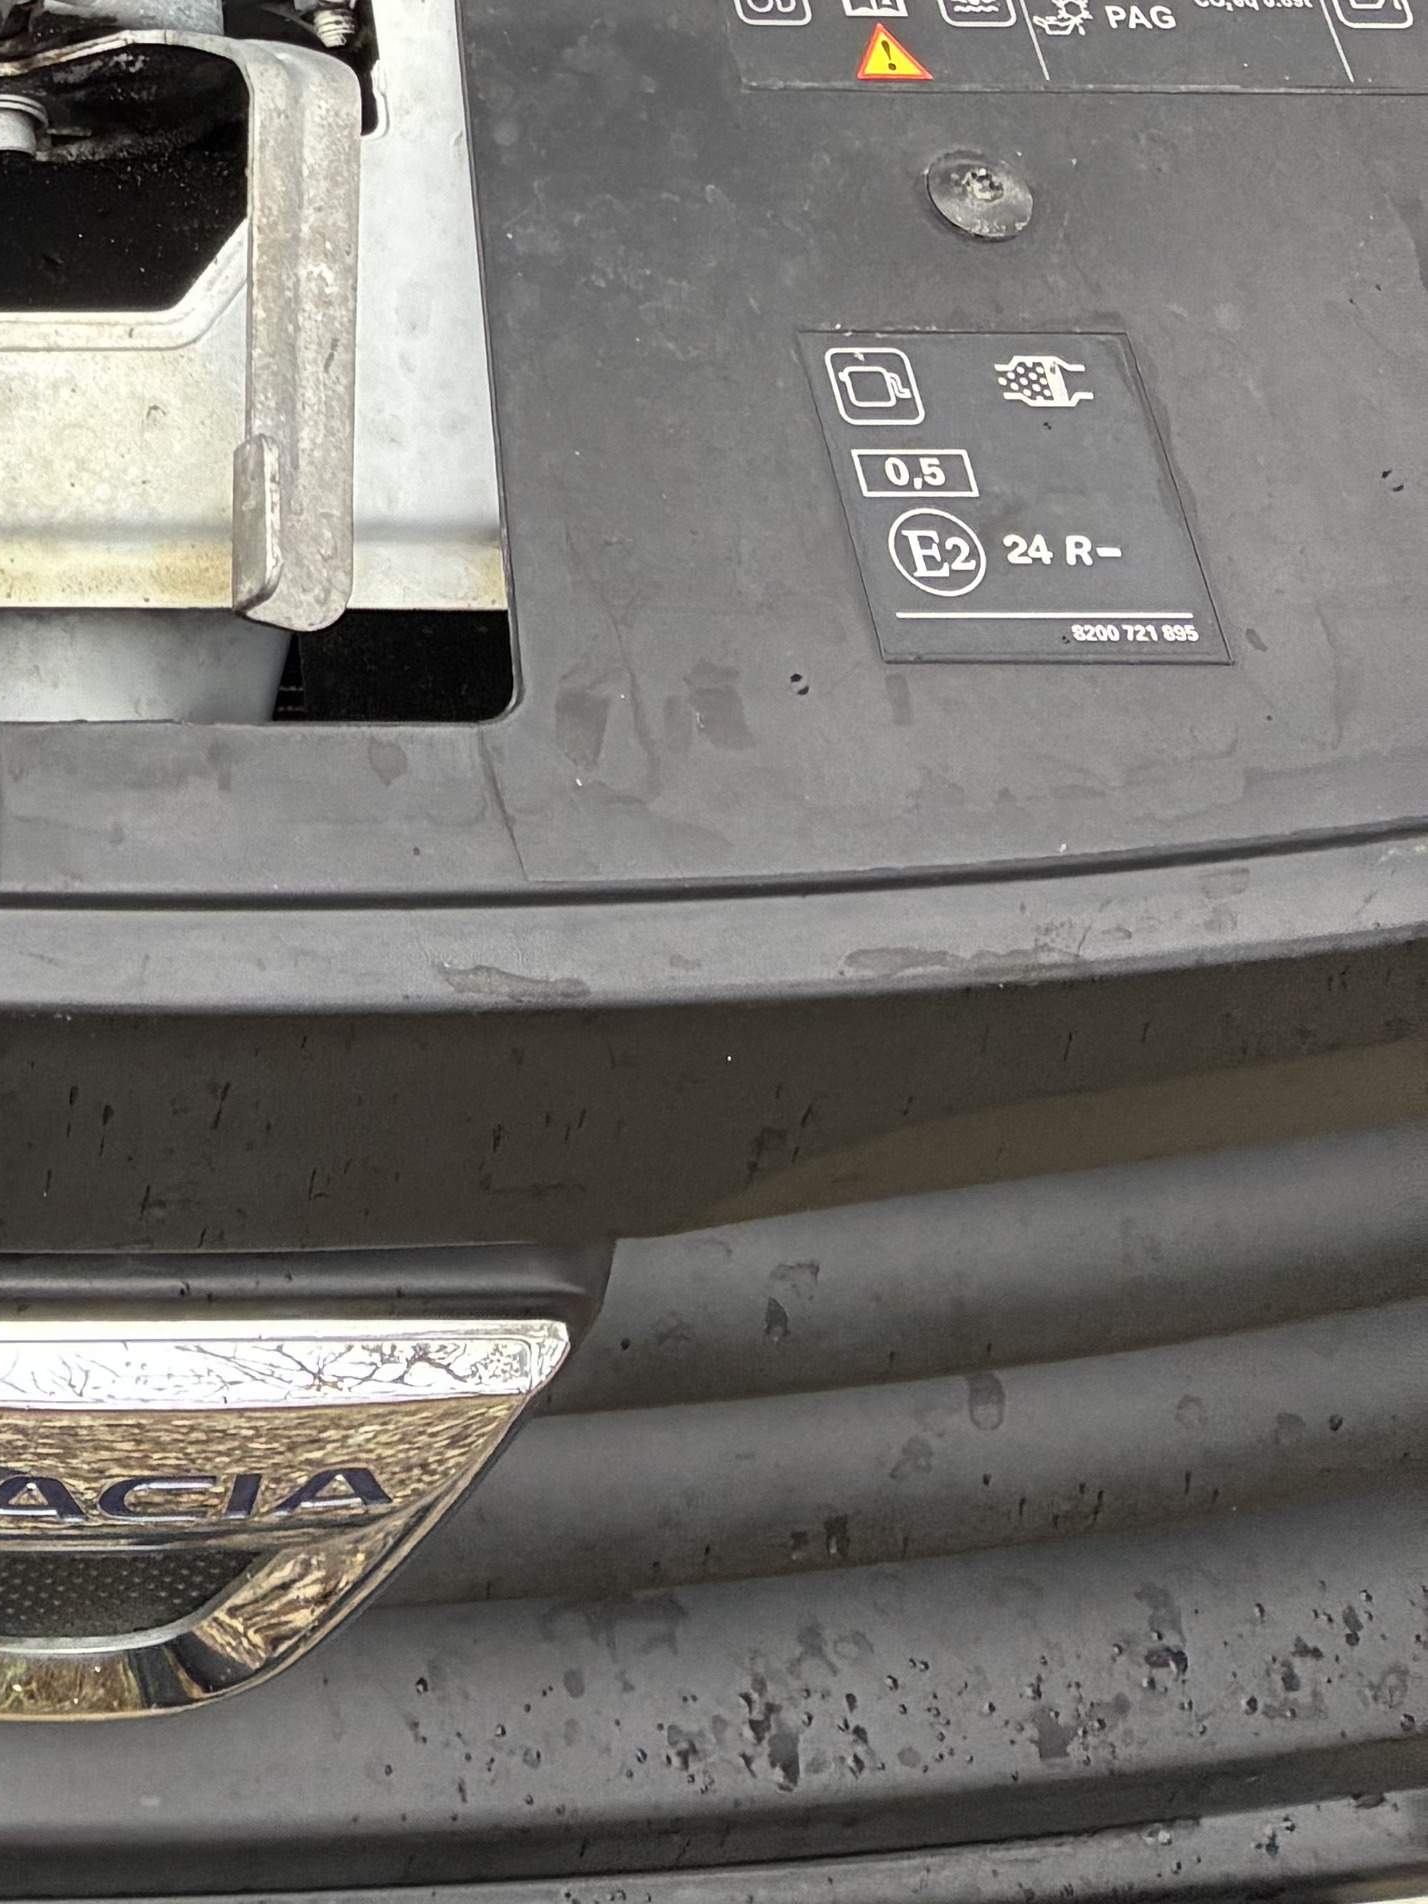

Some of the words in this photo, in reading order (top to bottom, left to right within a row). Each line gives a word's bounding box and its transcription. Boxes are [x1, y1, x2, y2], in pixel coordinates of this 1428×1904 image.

[1105, 6, 1177, 30] PAG
[884, 457, 945, 490] 0,5
[1003, 535, 1053, 565] 24
[1072, 625, 1120, 642] 8200
[1122, 625, 1157, 642] 721
[1162, 625, 1199, 642] 895
